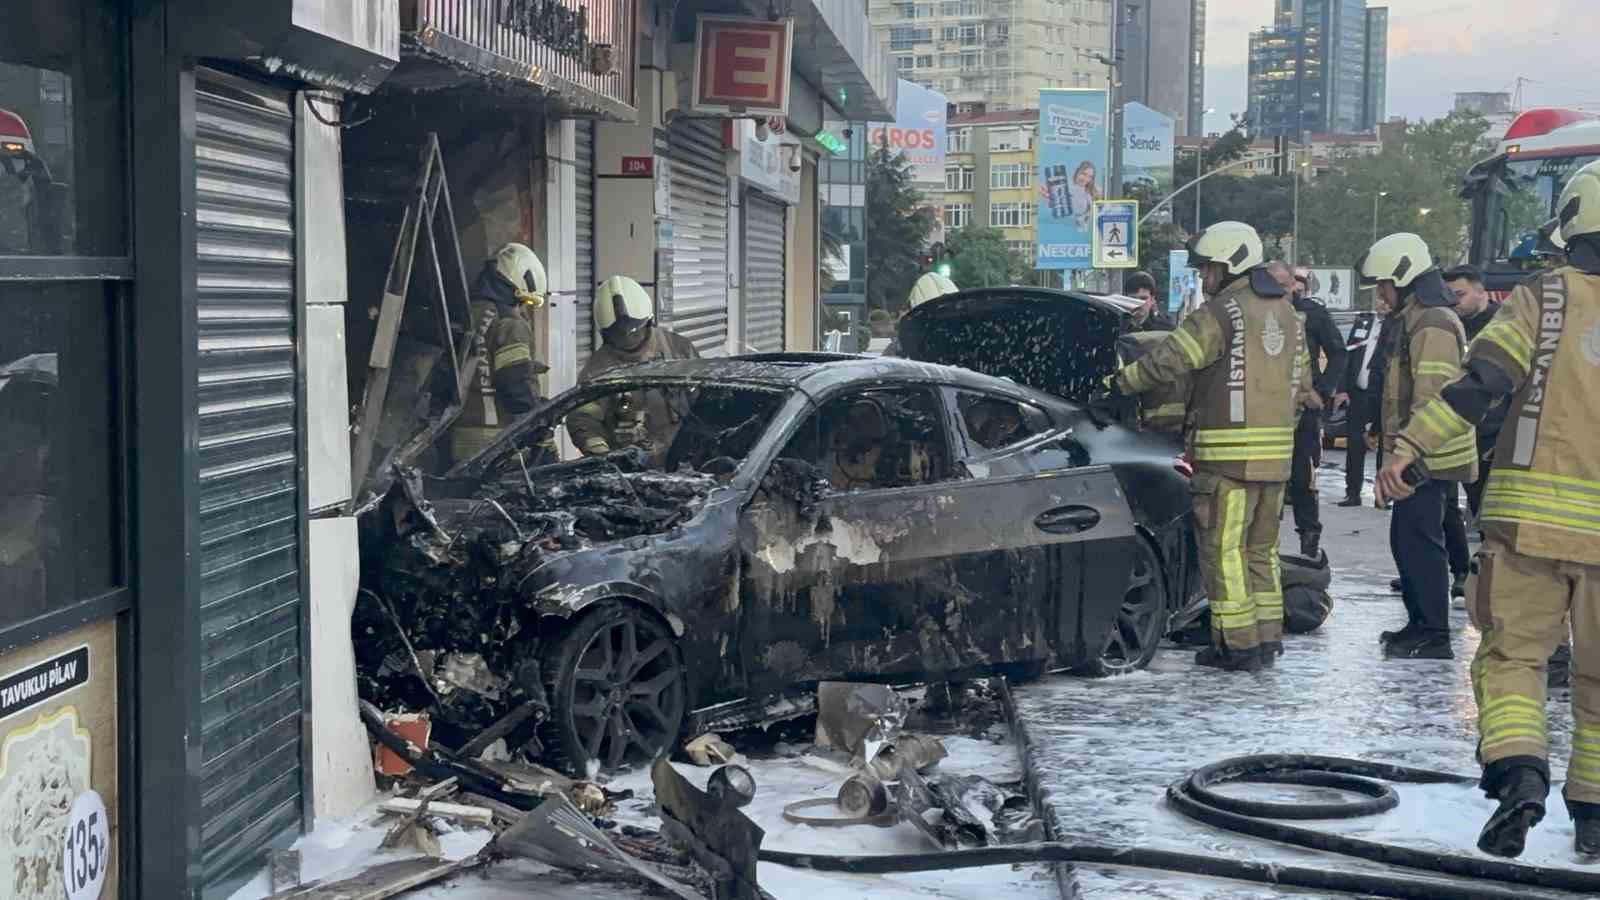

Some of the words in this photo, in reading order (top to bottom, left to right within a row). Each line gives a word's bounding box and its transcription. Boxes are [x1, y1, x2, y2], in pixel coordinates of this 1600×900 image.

[1130, 133, 1161, 151] Sende
[1, 671, 48, 709] TAVUKLU
[48, 660, 77, 689] PİLAV
